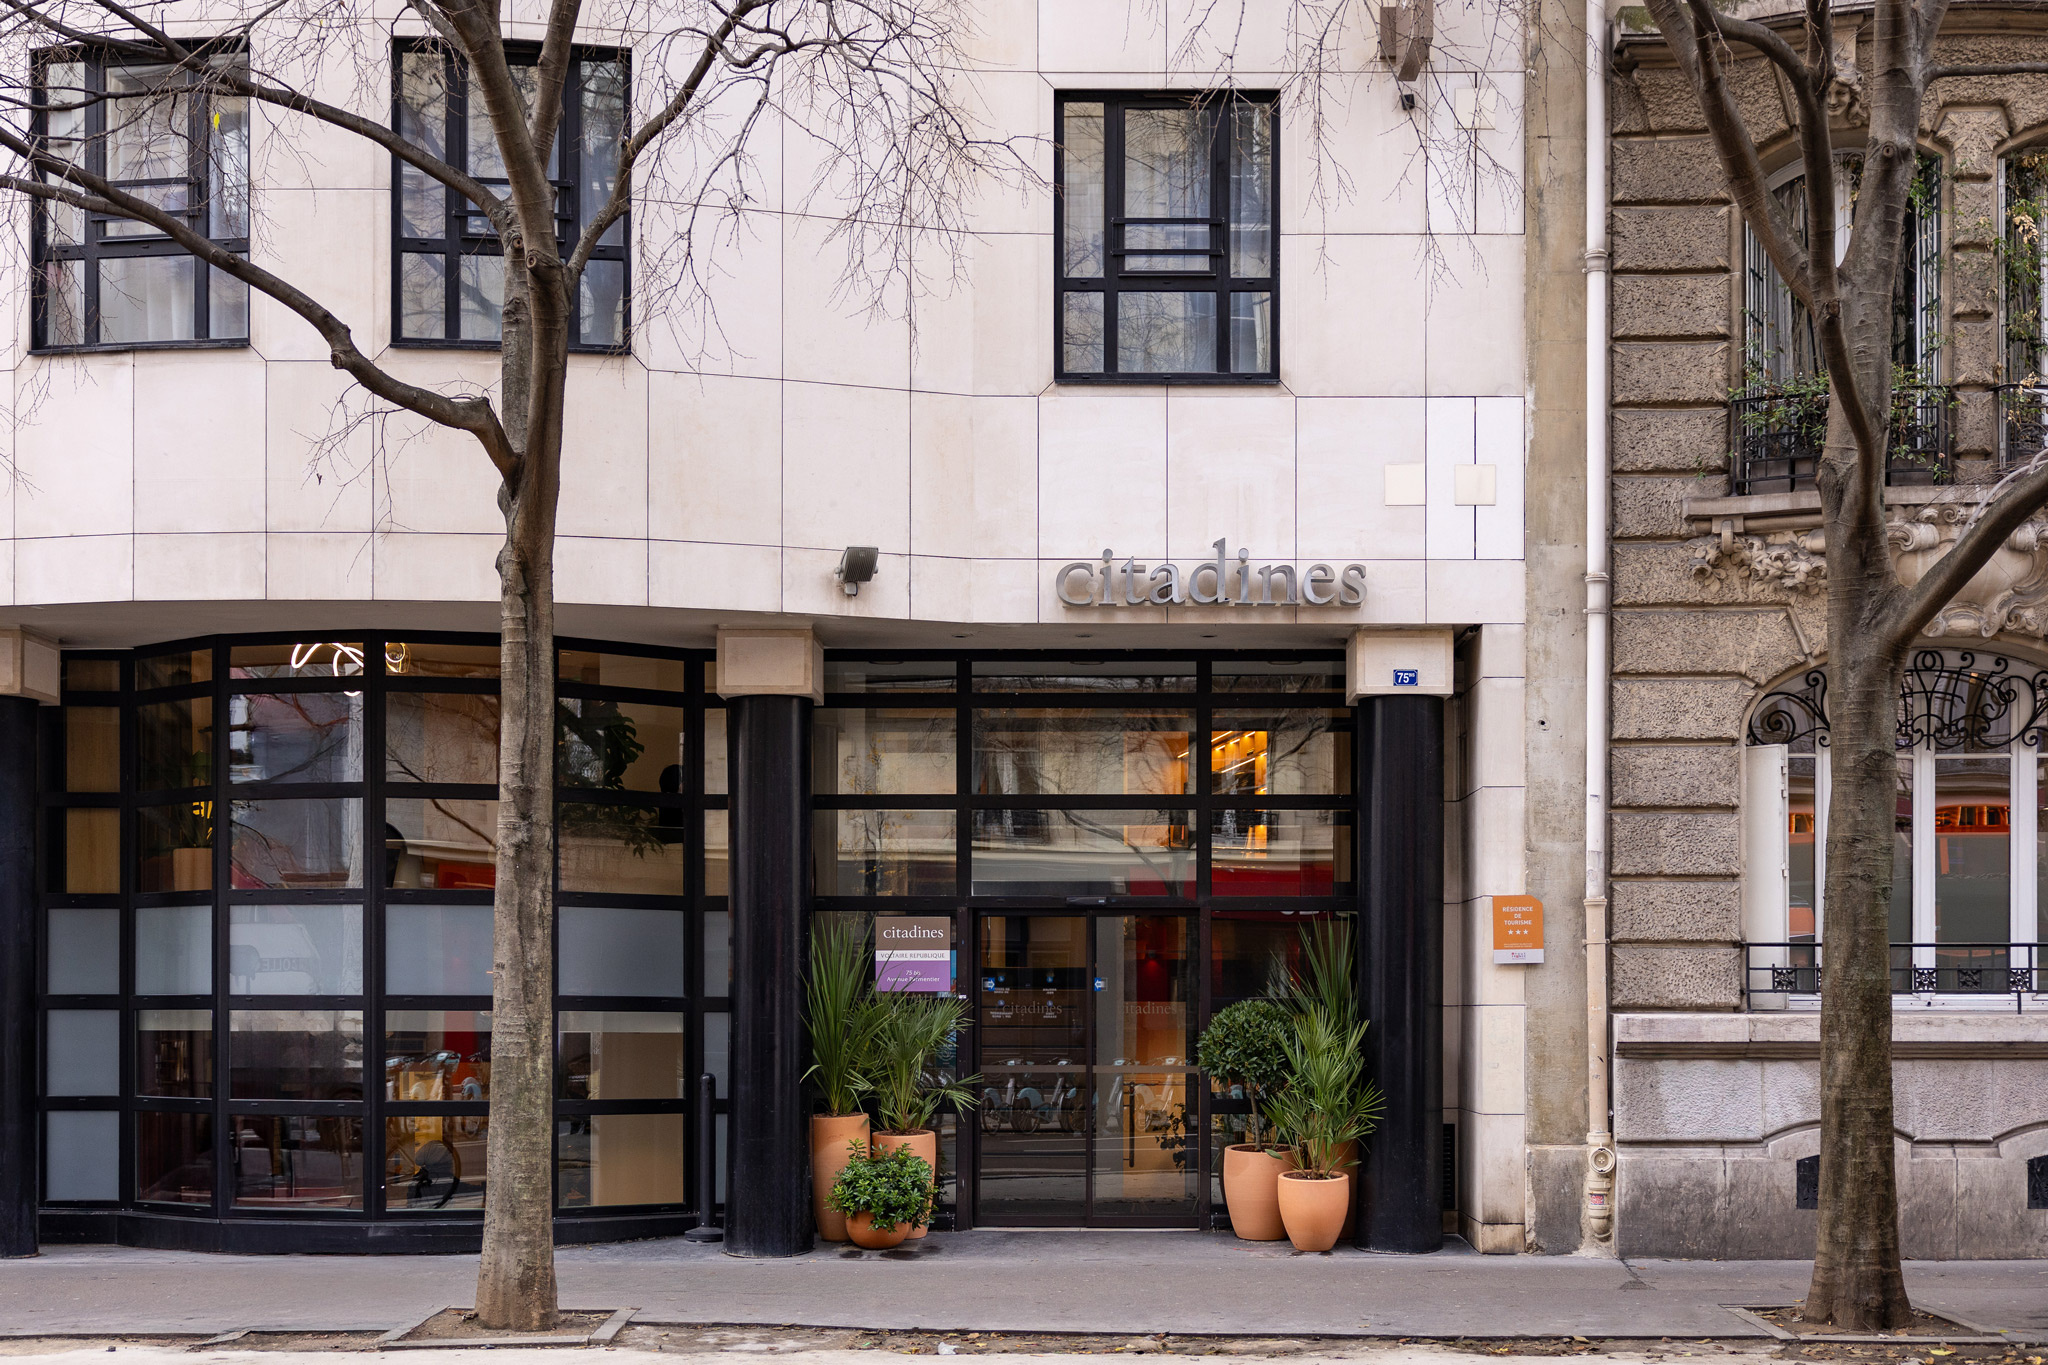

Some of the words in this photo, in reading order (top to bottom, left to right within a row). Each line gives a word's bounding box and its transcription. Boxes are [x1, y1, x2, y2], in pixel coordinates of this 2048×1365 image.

[1056, 537, 1367, 606] citadines
[883, 925, 943, 938] citadines
[1002, 1000, 1063, 1014] citadines
[1118, 1000, 1178, 1015] itadines
